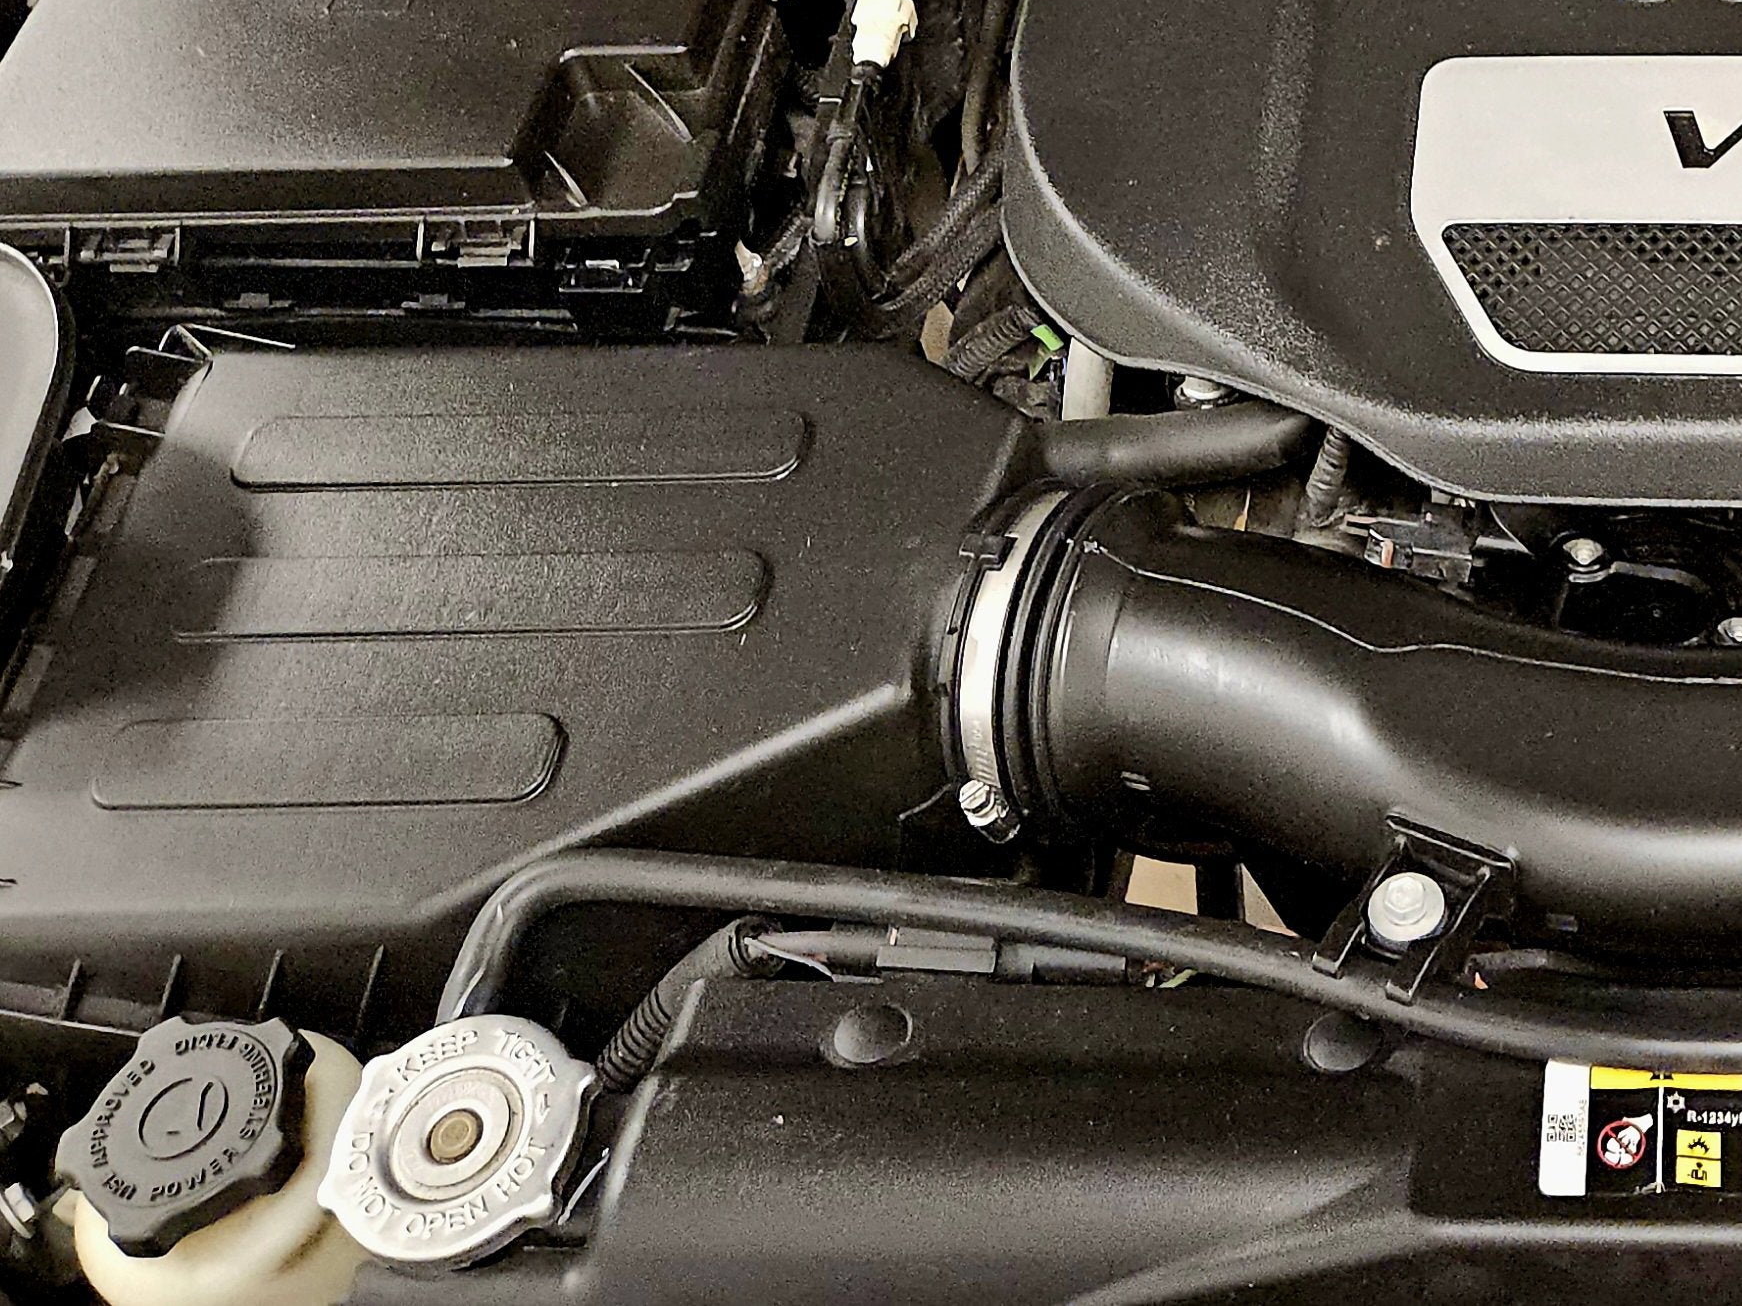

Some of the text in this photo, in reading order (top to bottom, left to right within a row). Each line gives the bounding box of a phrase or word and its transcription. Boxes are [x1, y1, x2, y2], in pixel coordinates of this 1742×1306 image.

[396, 1029, 557, 1084] KEEP TIGHT
[149, 1147, 242, 1202] POWER
[348, 1131, 547, 1239] DO NOT OPEN HOT
